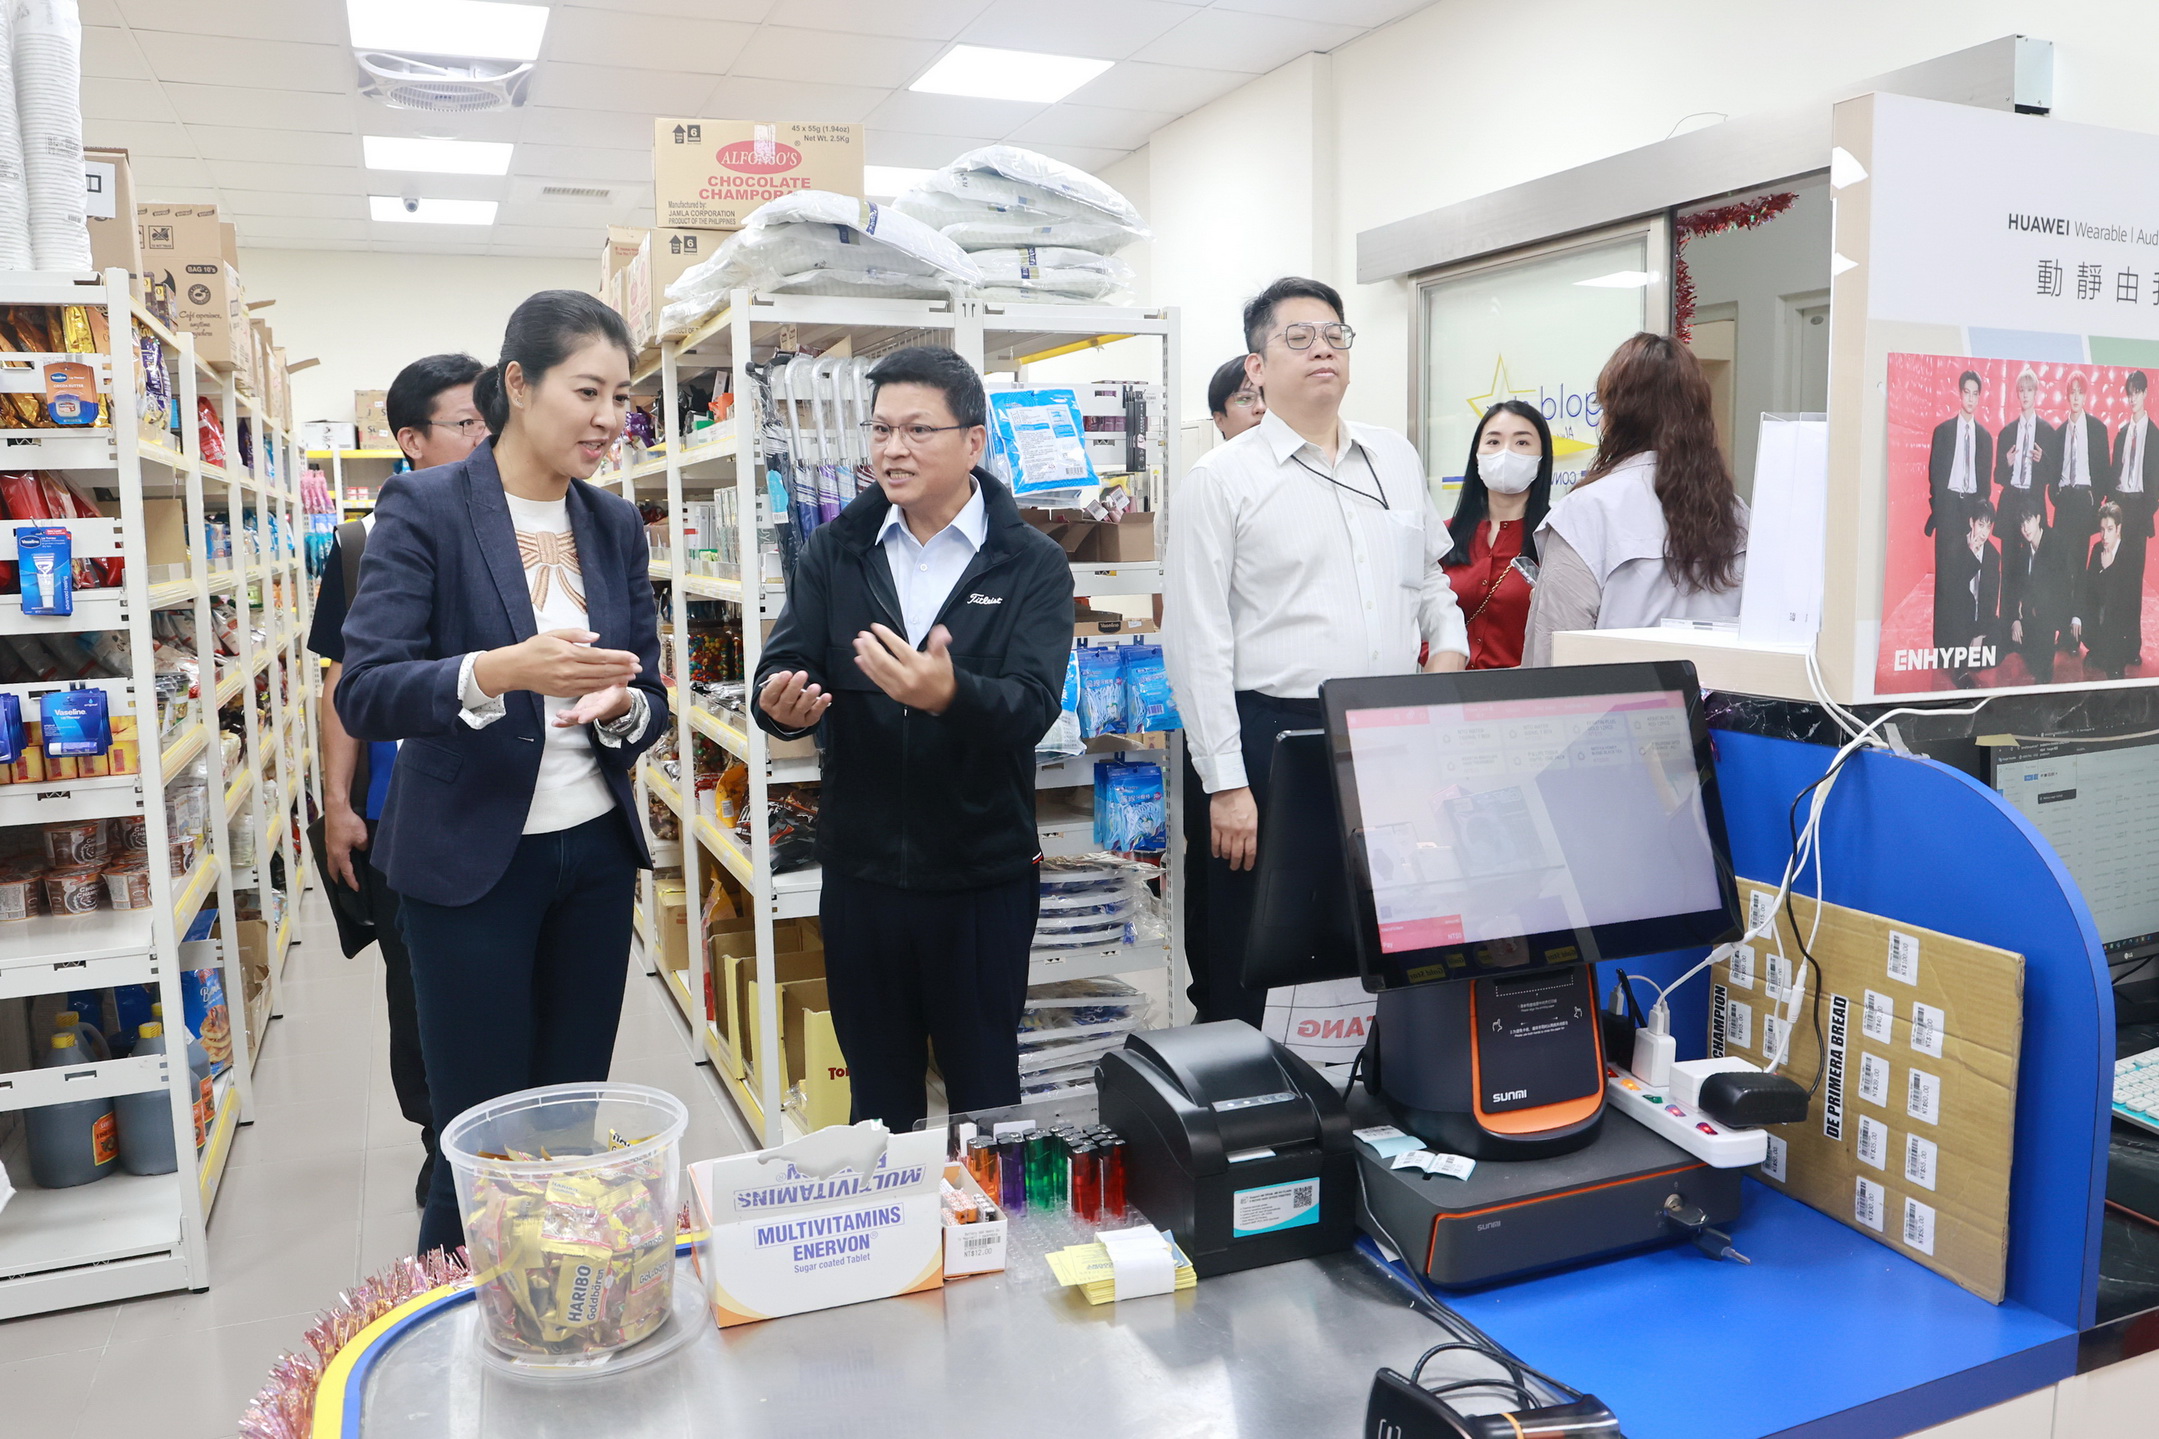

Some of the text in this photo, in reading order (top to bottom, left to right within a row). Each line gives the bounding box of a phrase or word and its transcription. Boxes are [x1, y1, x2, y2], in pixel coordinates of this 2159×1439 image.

[791, 125, 801, 133] 45
[808, 126, 821, 135] 55g
[822, 126, 850, 134] (1.94oz)
[830, 135, 849, 144] 2.5Kg
[699, 189, 796, 200] CHAMPOR
[707, 176, 811, 188] CHOCOLATE
[2008, 213, 2070, 236] HUAWEI
[2075, 221, 2128, 243] Wearable
[2036, 259, 2159, 306] 動靜由
[1893, 645, 1997, 672] ENHYPEN
[54, 708, 86, 716] Vaseline
[1712, 985, 1727, 1058] CHAMPION
[1826, 996, 1847, 1139] DE PRIMERA BREAD
[757, 1206, 901, 1246] MULTIVITAMINS
[793, 1233, 870, 1262] ENERVON
[794, 1252, 871, 1274] Sugar coated Tablet
[567, 1265, 592, 1322] HARIBO
[587, 1269, 605, 1321] Goldbären
